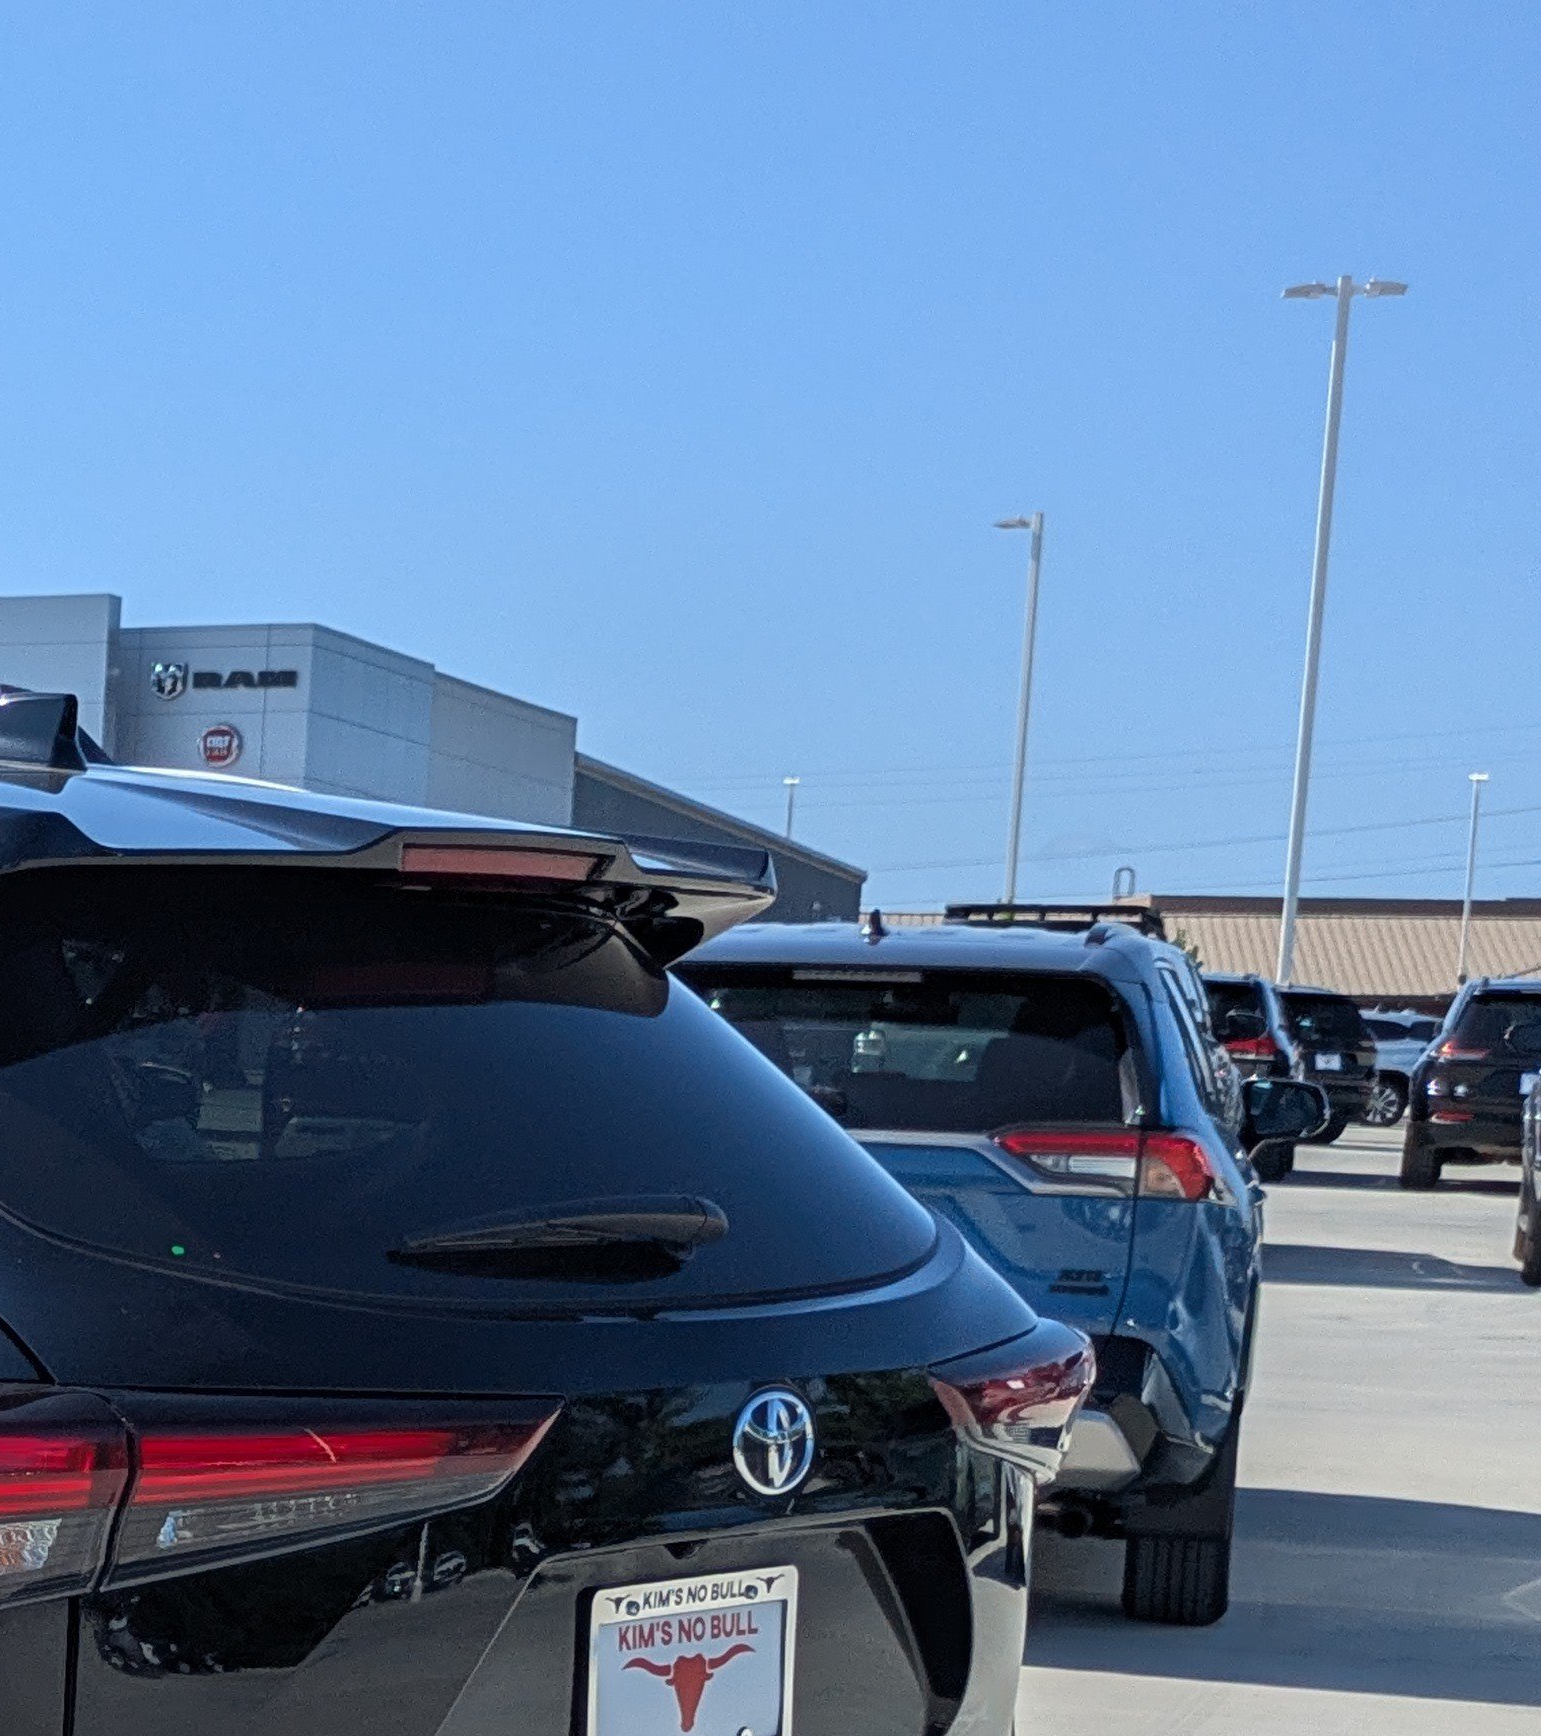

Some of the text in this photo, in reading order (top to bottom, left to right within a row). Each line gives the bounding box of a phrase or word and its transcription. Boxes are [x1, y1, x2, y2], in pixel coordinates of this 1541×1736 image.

[193, 671, 297, 688] RAM
[642, 1579, 745, 1611] KIM'S NO BULL
[618, 1610, 758, 1651] KIM'S NO BULL
